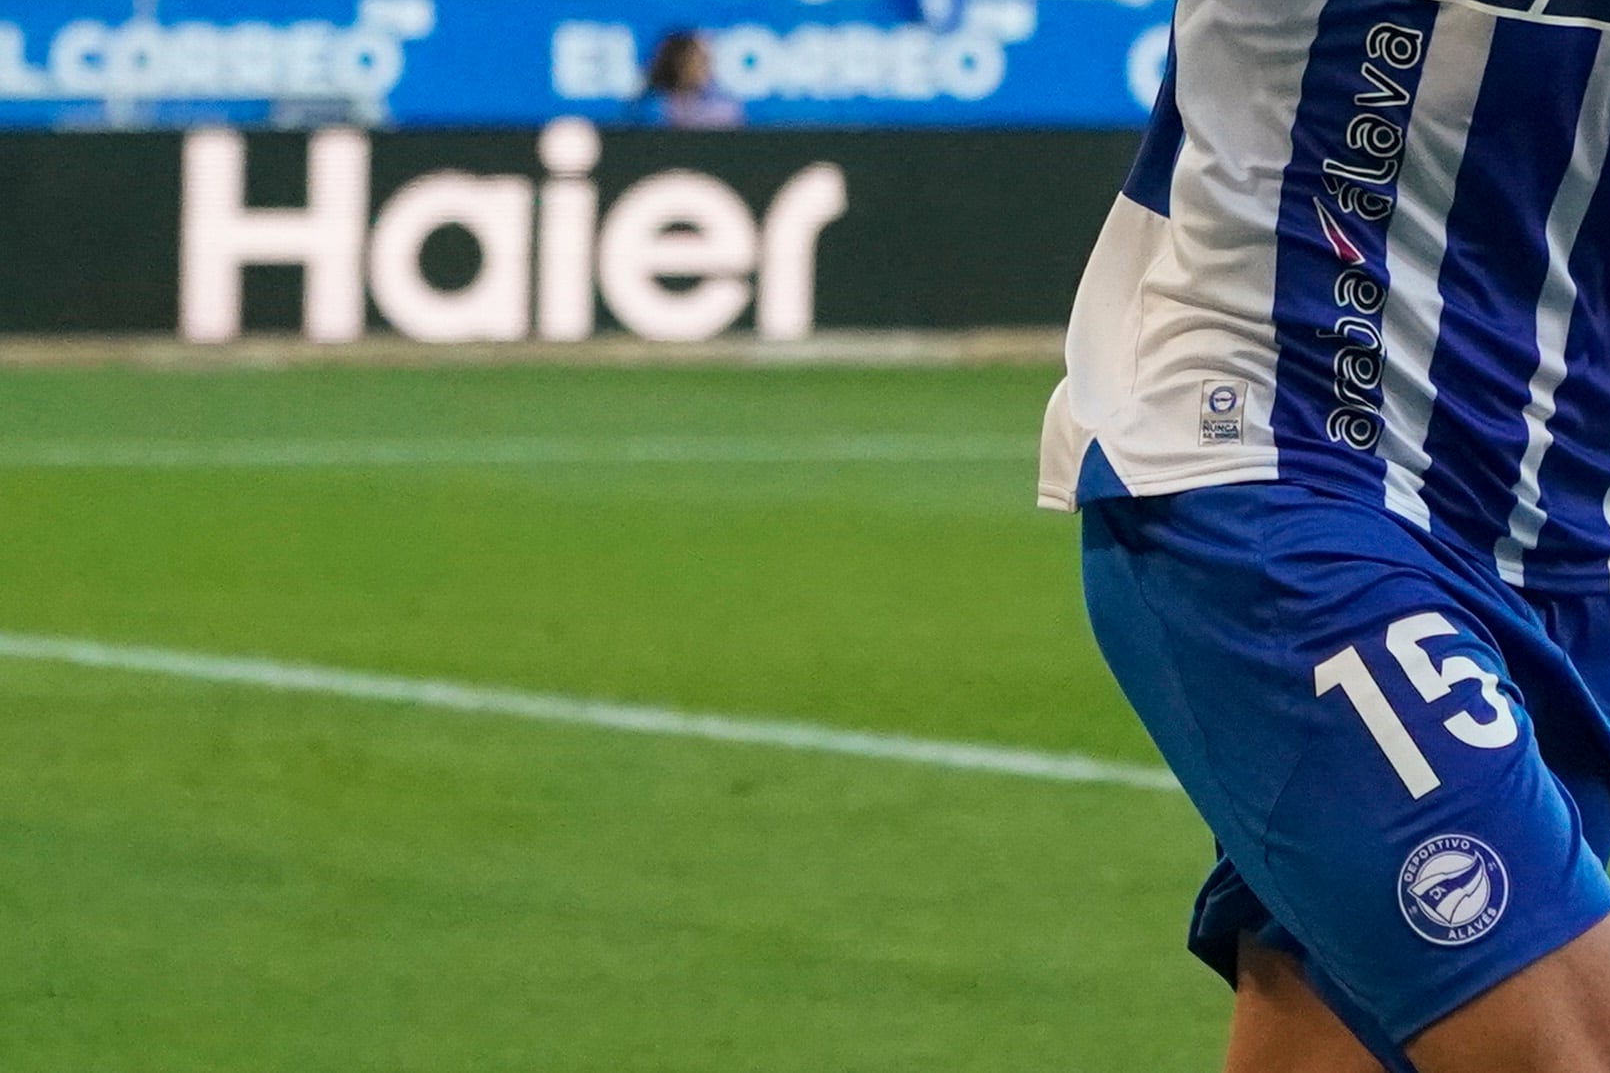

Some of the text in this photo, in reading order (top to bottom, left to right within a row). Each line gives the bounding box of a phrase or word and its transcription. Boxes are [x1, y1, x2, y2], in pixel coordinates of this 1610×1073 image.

[712, 23, 1004, 101] ORREO
[180, 117, 848, 344] Haier
[1313, 611, 1518, 801] 15
[1403, 838, 1471, 883] DEPORTIVO
